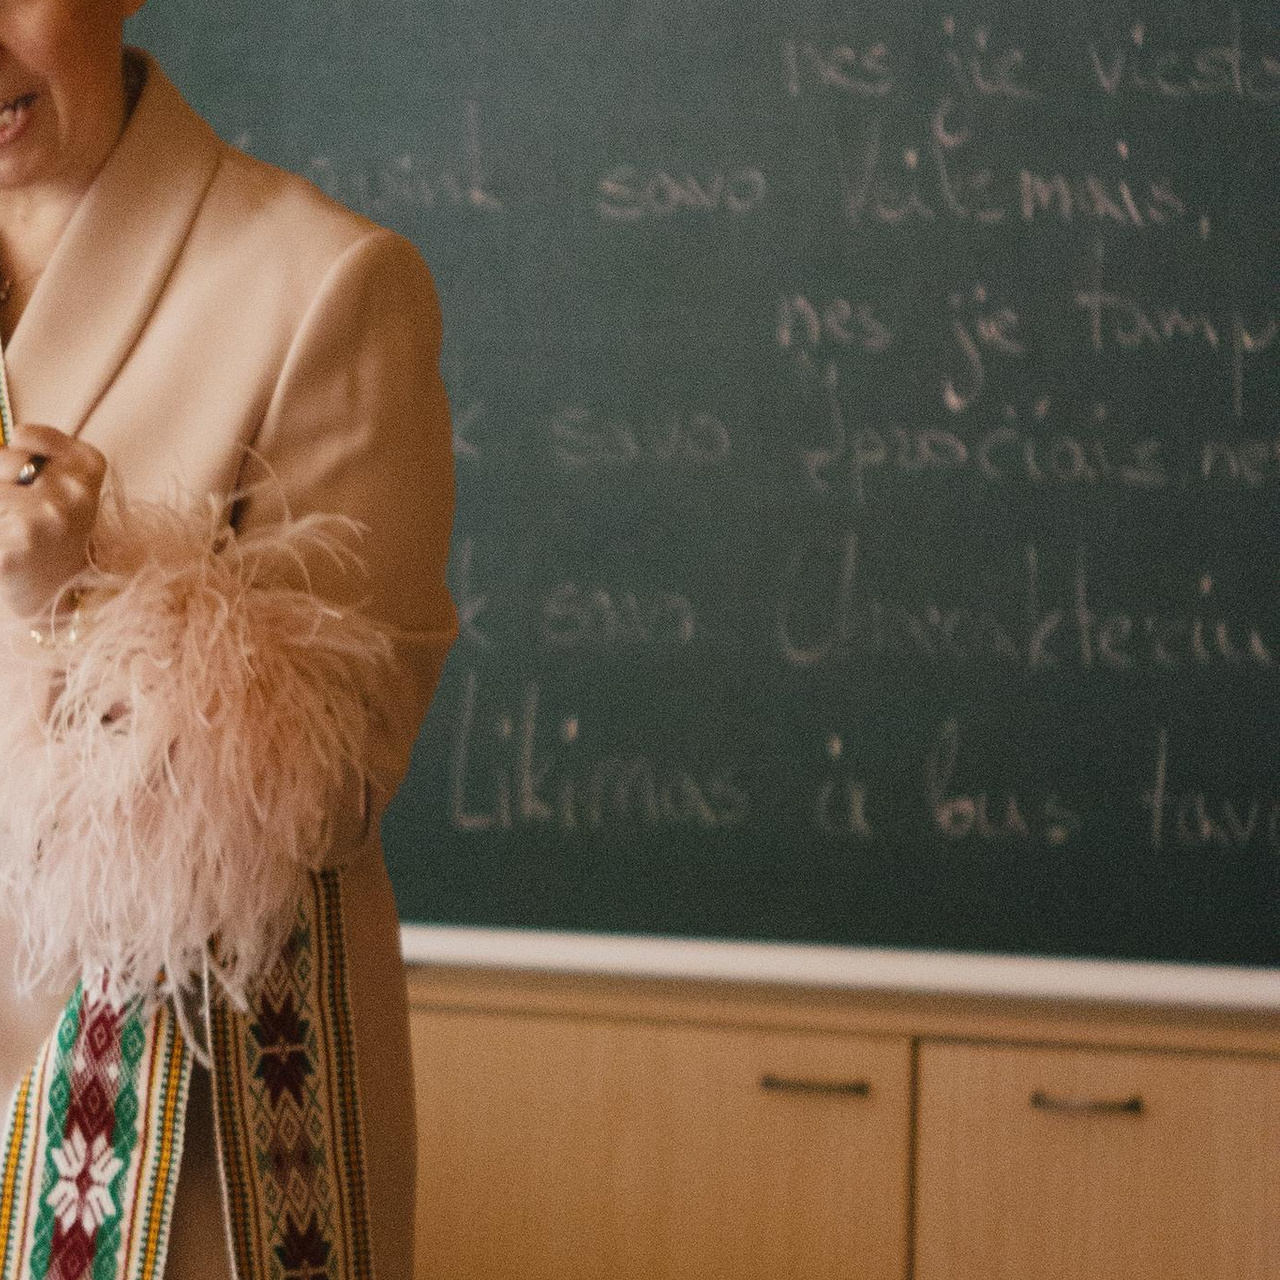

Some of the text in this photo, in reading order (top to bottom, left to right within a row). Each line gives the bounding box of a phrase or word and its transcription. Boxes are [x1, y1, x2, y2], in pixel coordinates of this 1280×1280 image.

[595, 164, 769, 221] savo
[777, 292, 895, 353] nes
[542, 577, 697, 647] savo
[451, 668, 750, 832] Likimas
